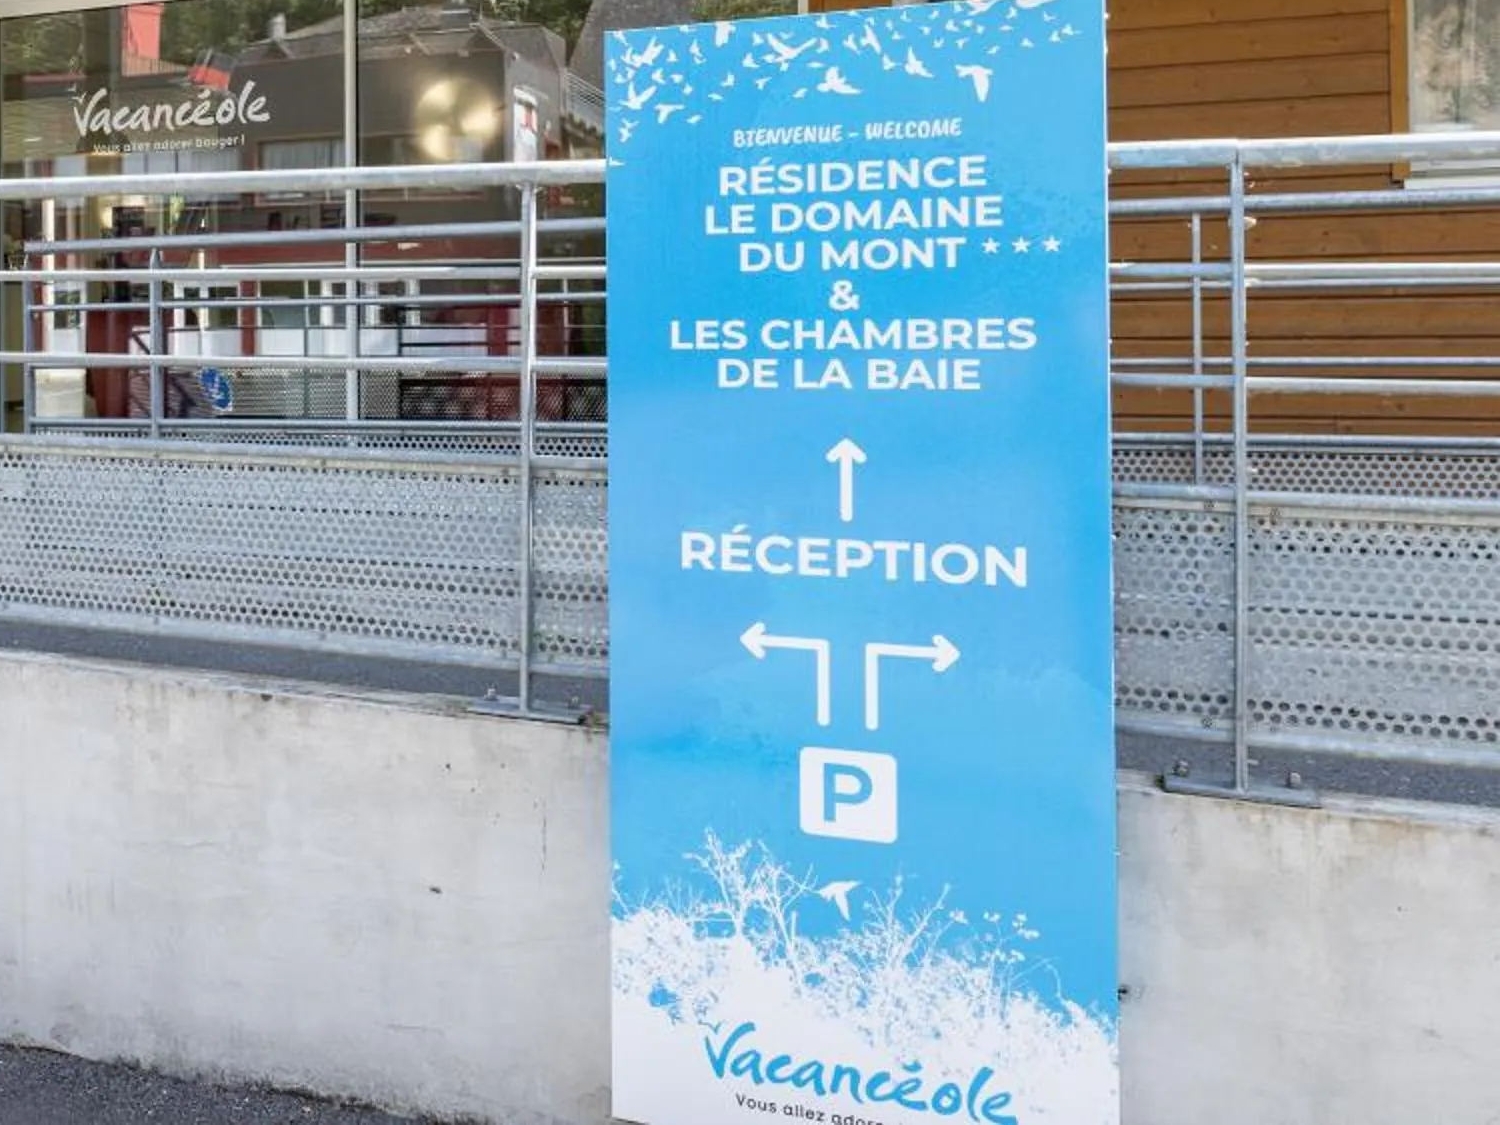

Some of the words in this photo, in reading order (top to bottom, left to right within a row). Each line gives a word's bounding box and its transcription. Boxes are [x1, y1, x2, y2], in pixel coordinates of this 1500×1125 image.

[72, 78, 271, 137] Vacancéole
[733, 123, 843, 148] BIENVENUE
[864, 117, 962, 140] WELCOME
[719, 154, 987, 196] RÉSIDENCE
[705, 204, 755, 235] LE
[771, 195, 1003, 233] DOMAINE
[739, 241, 804, 272] DU
[821, 237, 966, 271] MONT
[829, 280, 860, 311] &
[670, 319, 748, 350] LES
[760, 318, 1038, 351] CHAMBRES
[718, 358, 779, 389] DE
[794, 358, 853, 390] LA
[867, 358, 981, 390] BAIE
[680, 524, 1028, 587] RÉCEPTION
[822, 762, 873, 823] P
[704, 1021, 1018, 1125] Vacancéole
[735, 1092, 777, 1115] Vous
[783, 1103, 825, 1124] allez
